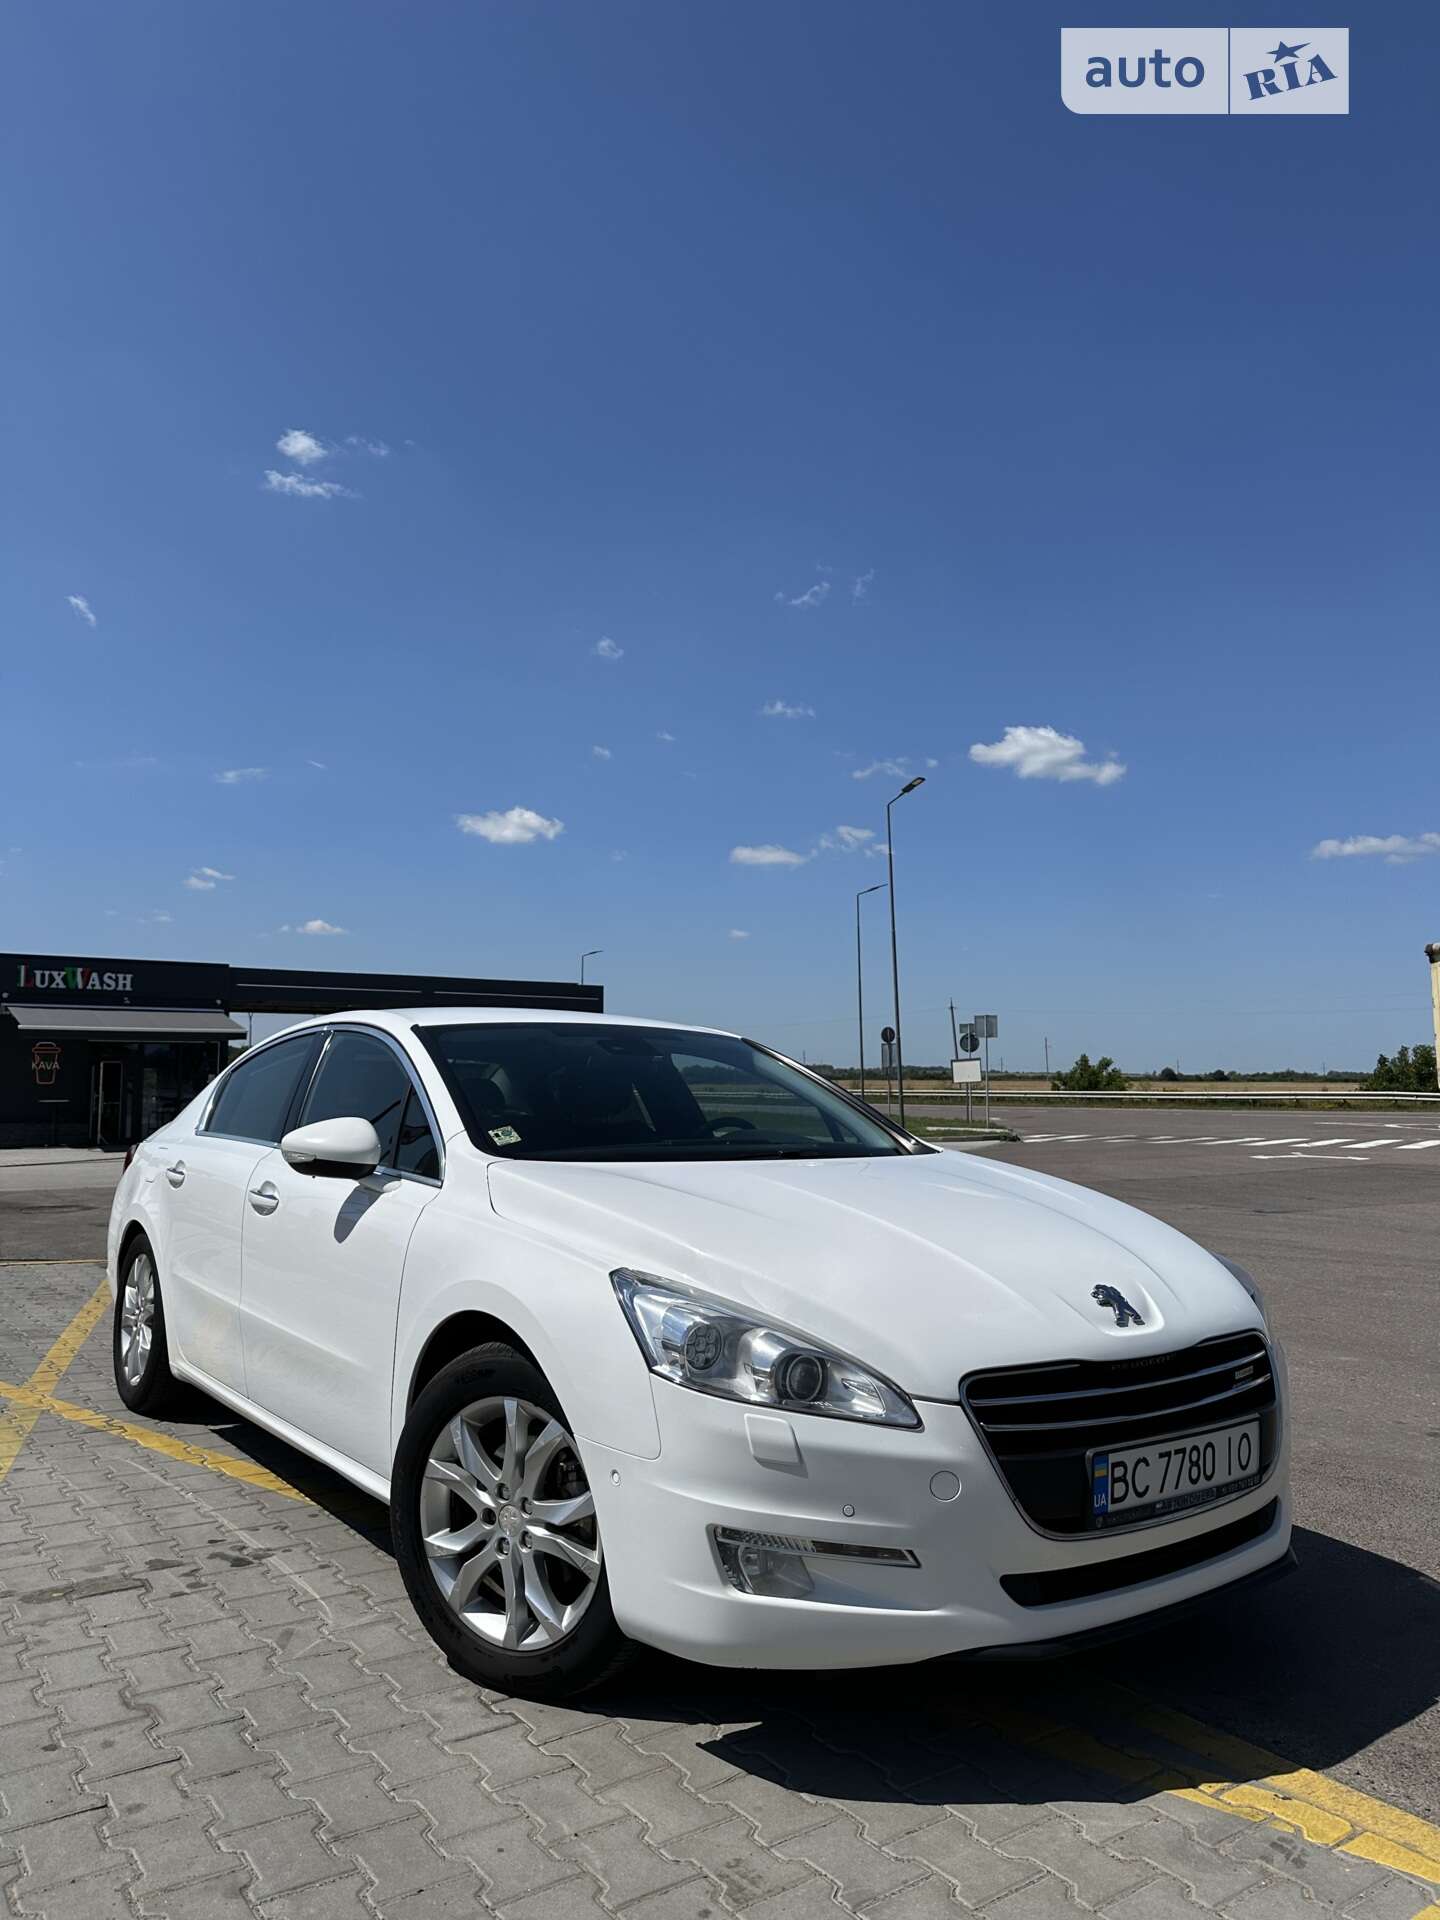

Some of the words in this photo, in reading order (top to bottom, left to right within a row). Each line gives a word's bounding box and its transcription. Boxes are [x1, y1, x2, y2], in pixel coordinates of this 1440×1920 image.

[32, 1061, 60, 1070] KAVA
[1110, 1456, 1150, 1504] BC
[1158, 1441, 1216, 1494] 7780
[1227, 1432, 1251, 1476] IO
[1093, 1493, 1107, 1508] UA
